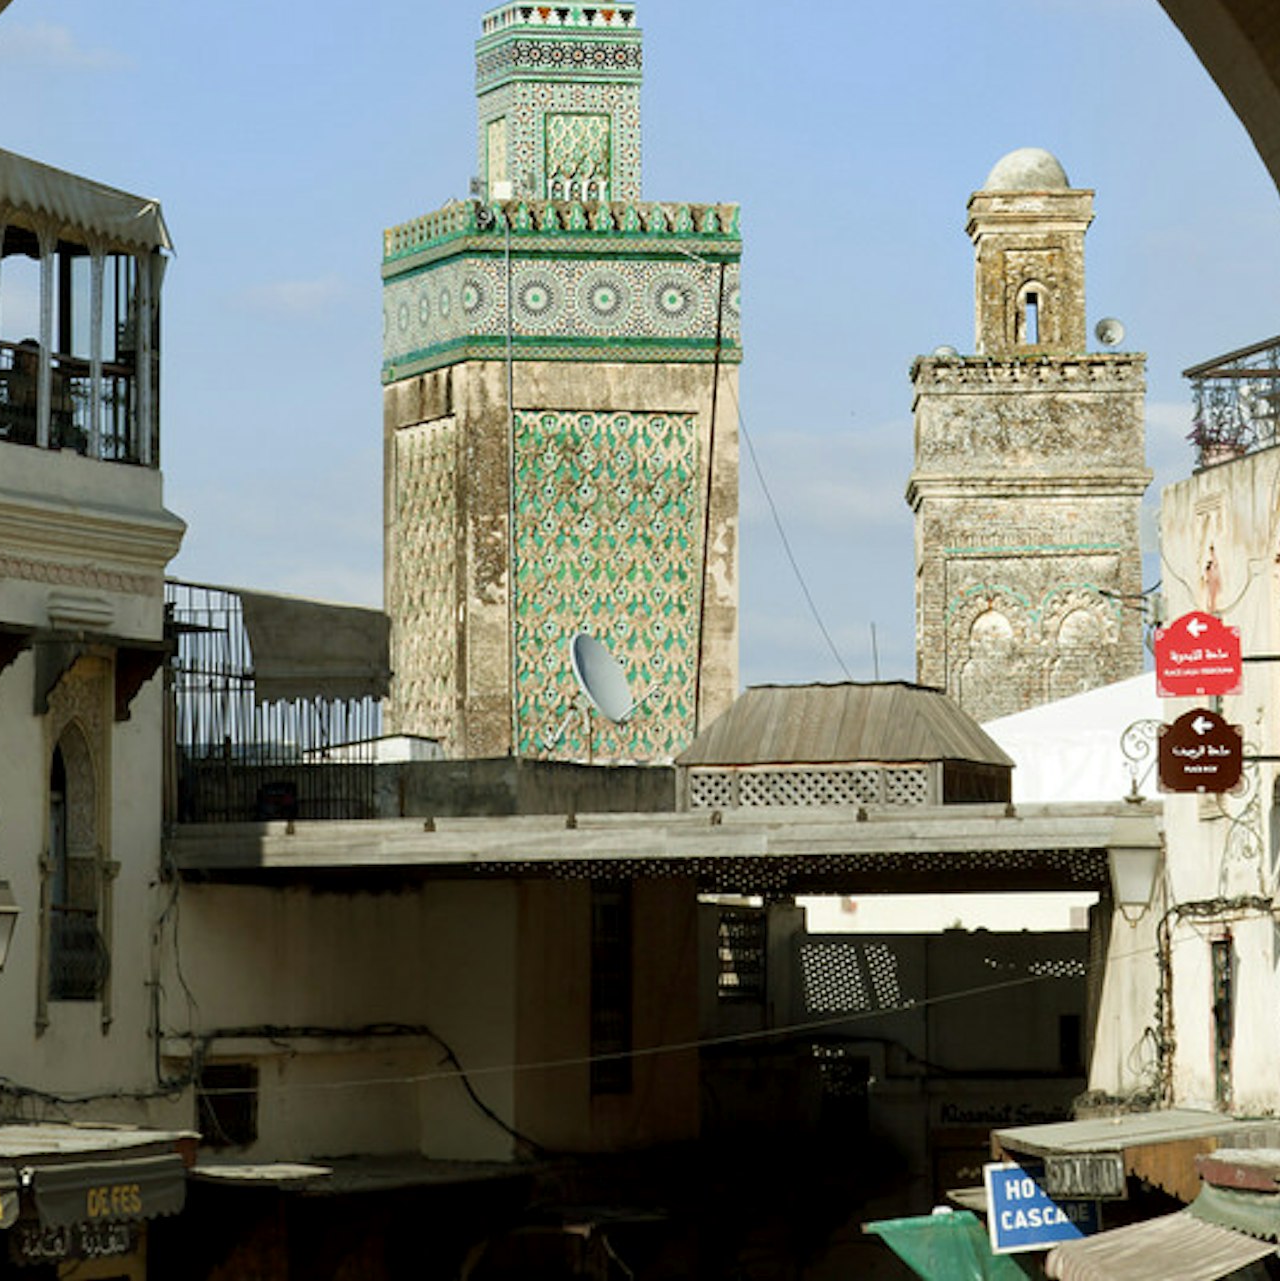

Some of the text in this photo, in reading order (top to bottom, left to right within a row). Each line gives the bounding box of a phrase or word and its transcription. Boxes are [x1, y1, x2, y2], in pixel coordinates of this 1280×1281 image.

[87, 1184, 143, 1217] DE FES
[1005, 1178, 1047, 1200] HO
